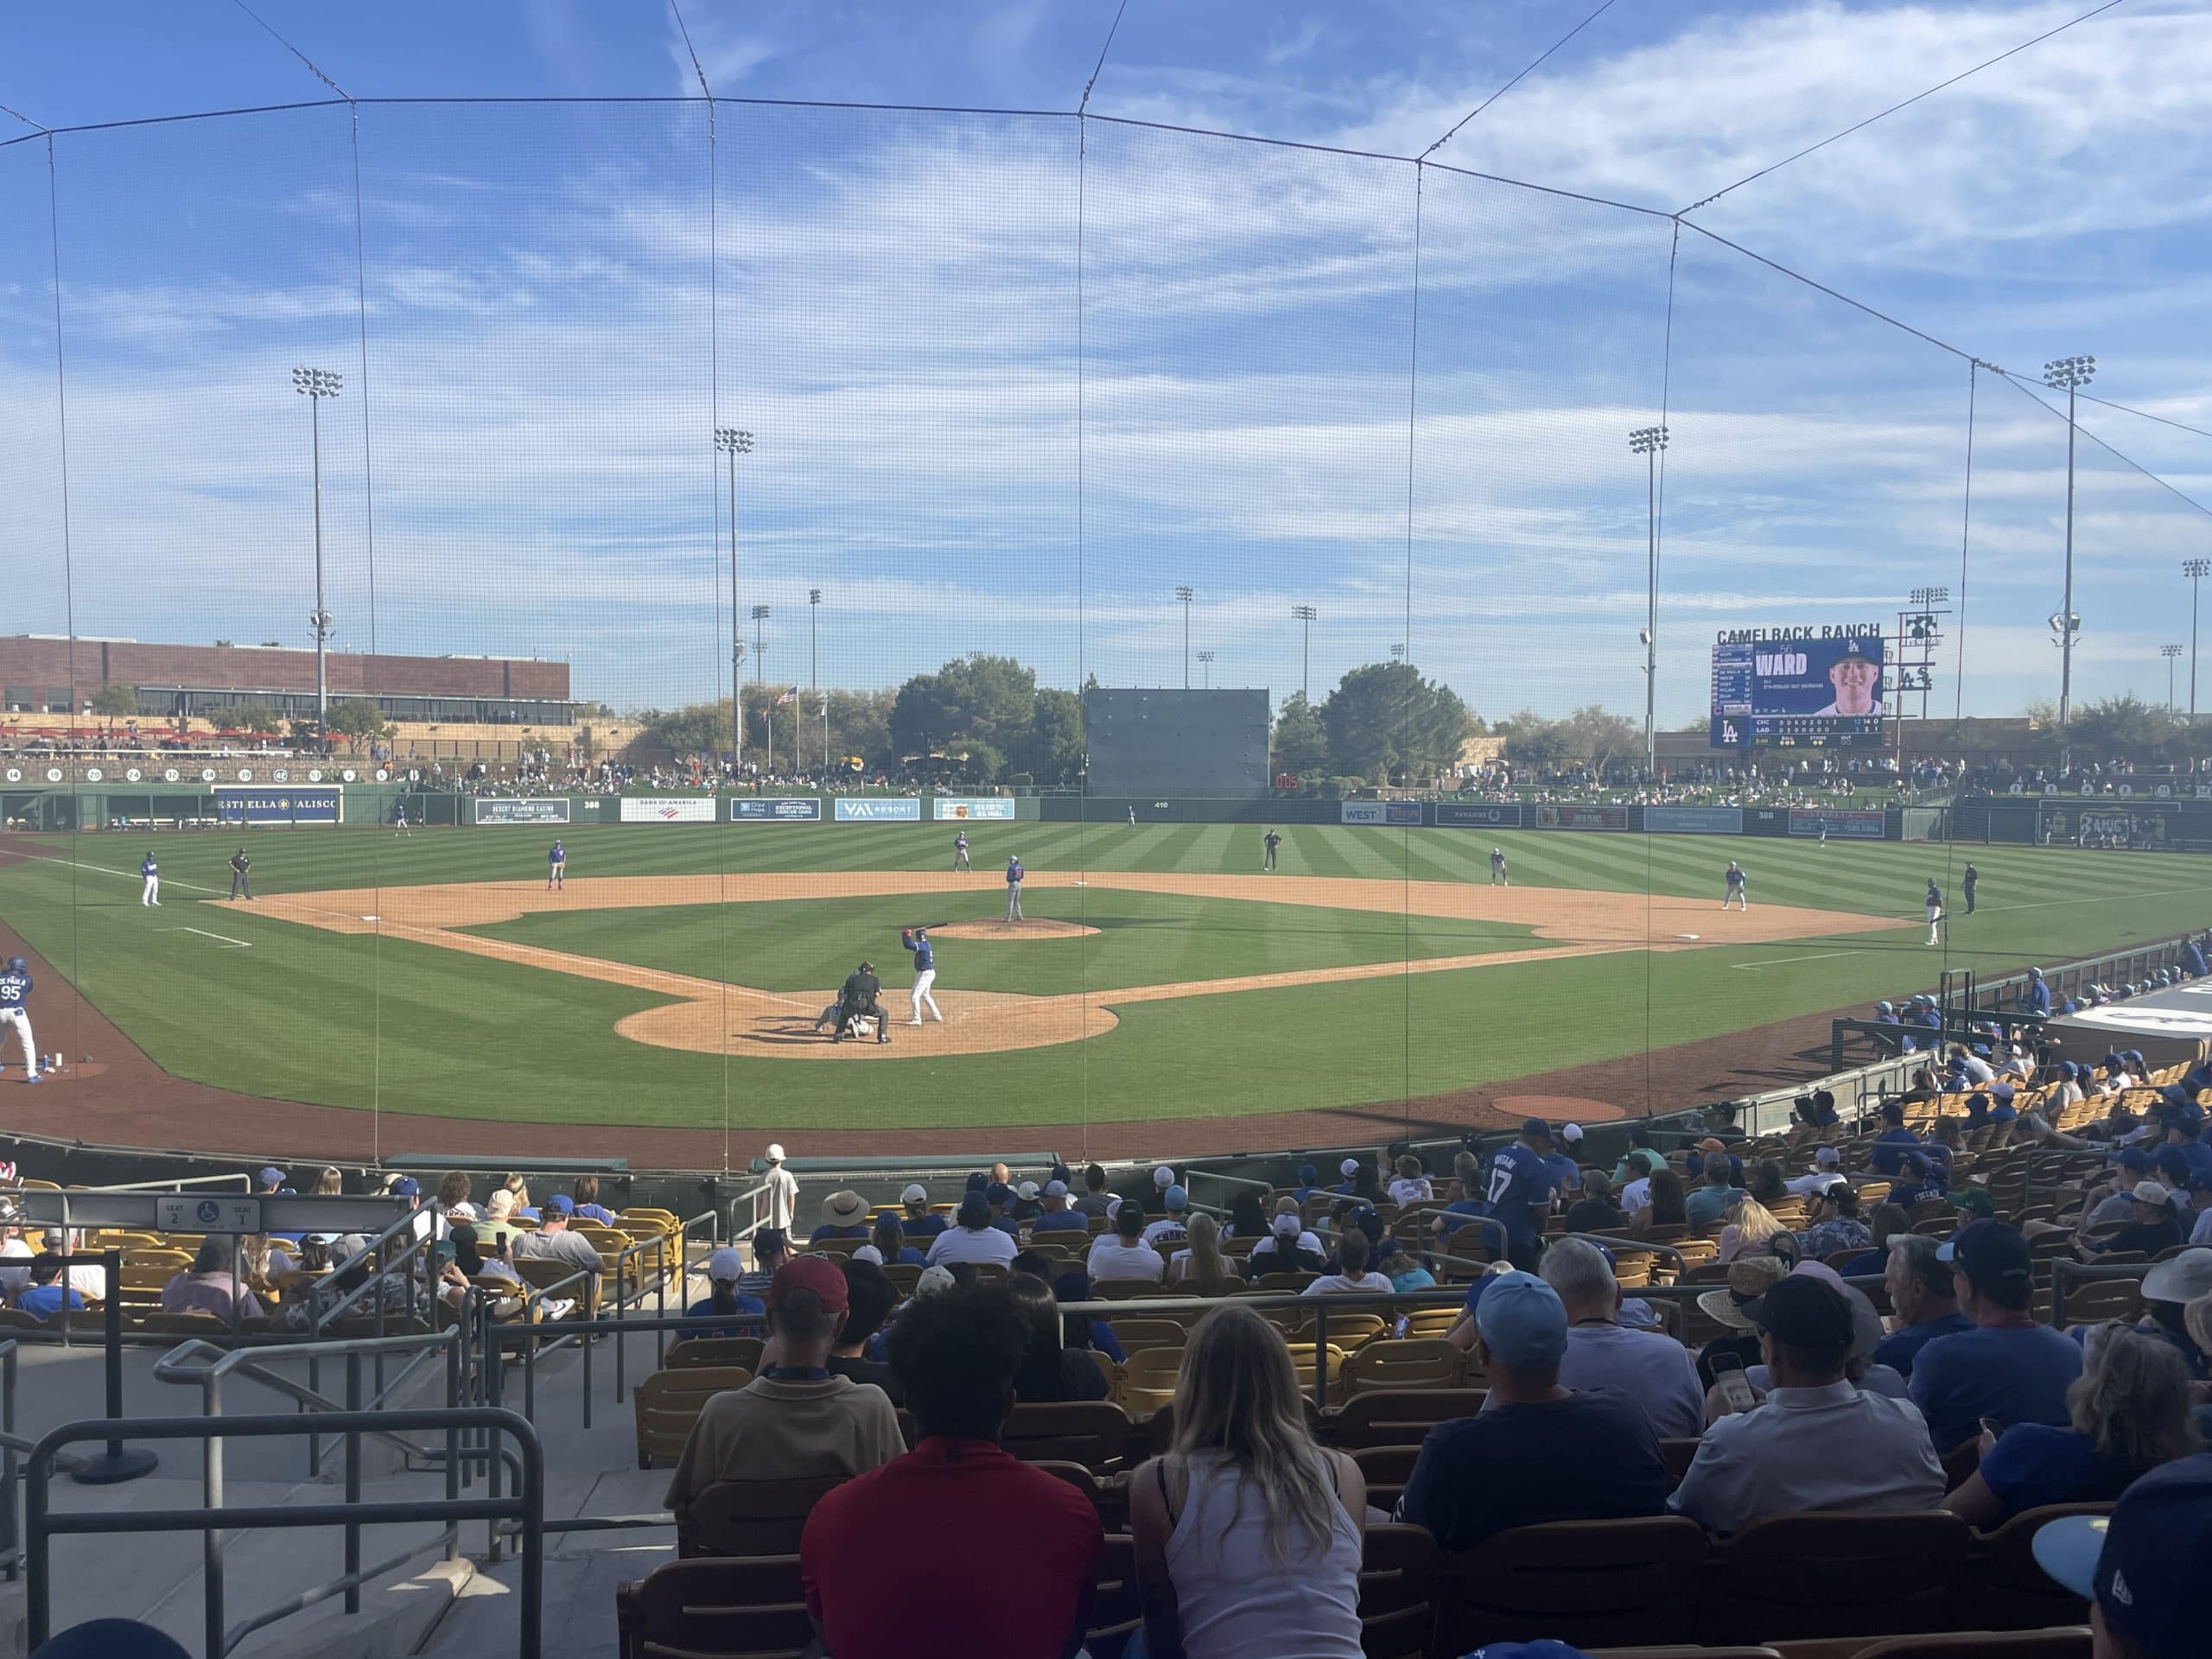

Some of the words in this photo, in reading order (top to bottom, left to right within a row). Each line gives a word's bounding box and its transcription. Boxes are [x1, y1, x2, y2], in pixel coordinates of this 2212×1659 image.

[1717, 626, 1814, 644] CAMELBACK
[1821, 623, 1880, 639] RANCH
[1756, 653, 1807, 677] WARD
[1722, 720, 1738, 742] LA
[1345, 810, 1376, 819] WEST
[1, 985, 21, 1001] 95
[1487, 1168, 1512, 1203] 17
[171, 1213, 178, 1224] 2
